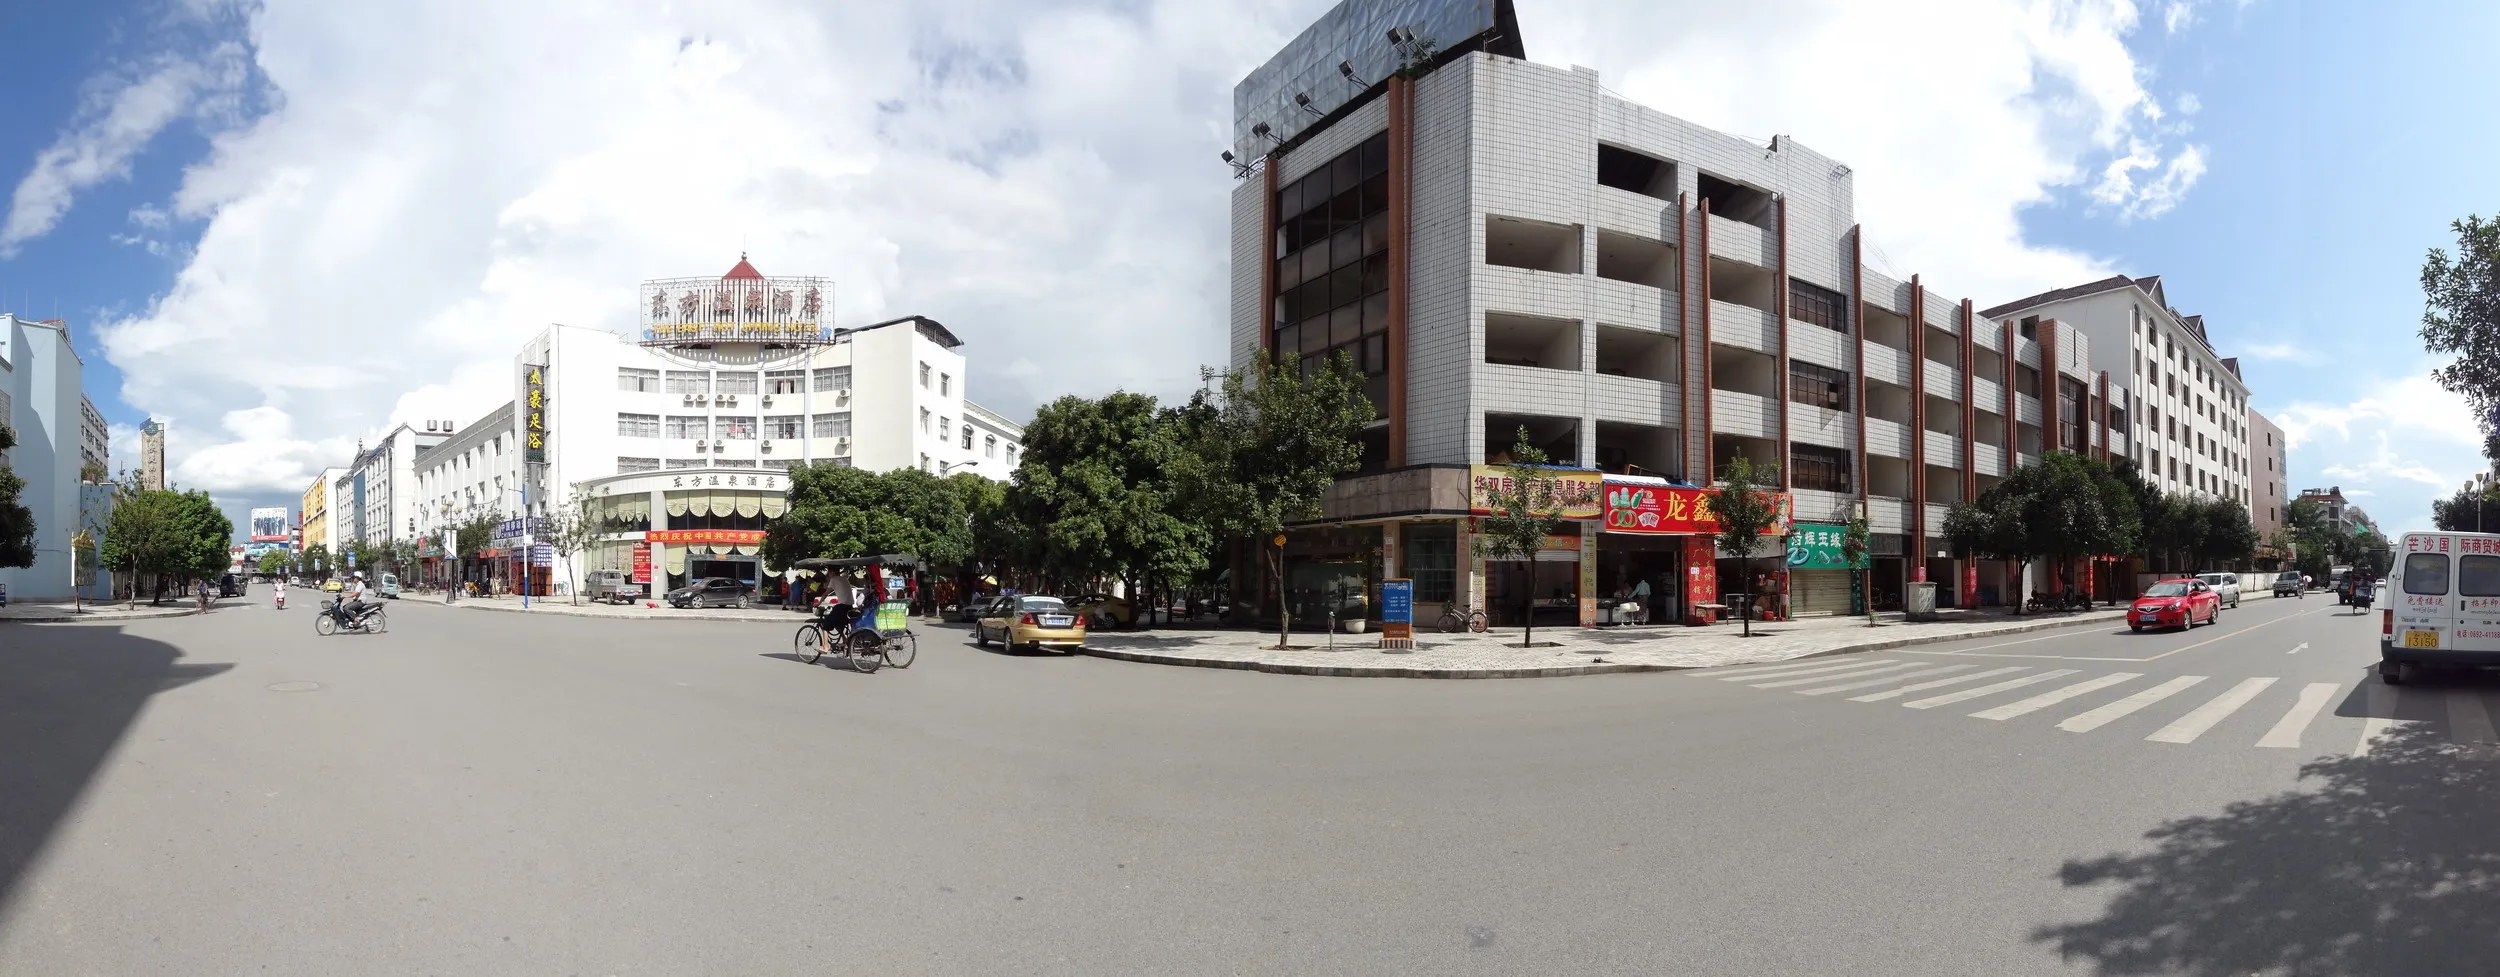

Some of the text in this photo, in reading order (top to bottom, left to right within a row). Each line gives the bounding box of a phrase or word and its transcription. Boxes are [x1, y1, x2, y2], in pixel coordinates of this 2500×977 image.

[652, 287, 822, 319] 东方温泉酒店
[652, 322, 819, 334] THE EAST HOT SPRING HOTEL
[673, 475, 776, 489] 东方温泉酒店
[1474, 475, 1600, 496] 华双房产信息服务部
[2408, 637, 2437, 648] 13150
